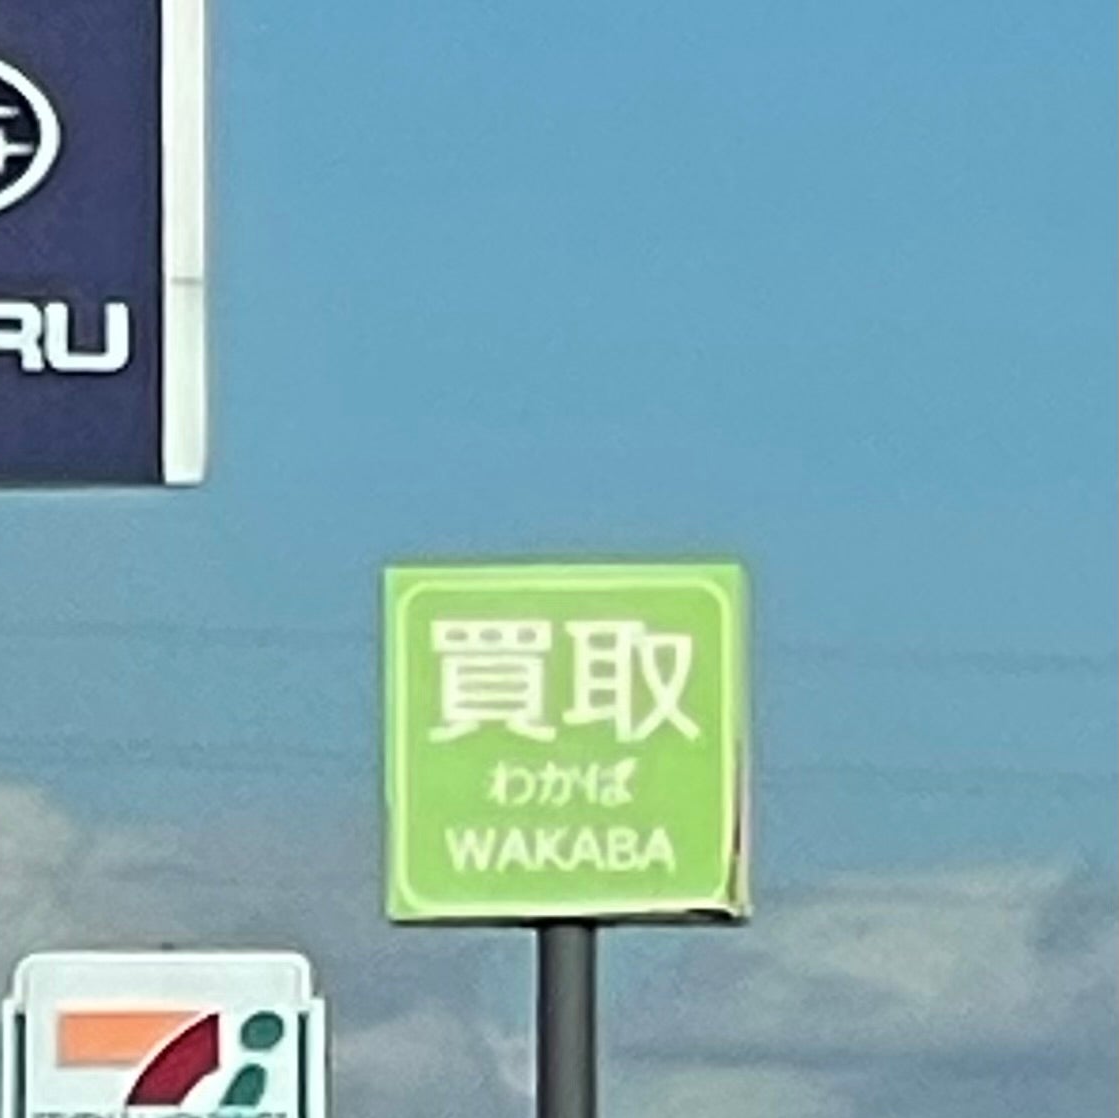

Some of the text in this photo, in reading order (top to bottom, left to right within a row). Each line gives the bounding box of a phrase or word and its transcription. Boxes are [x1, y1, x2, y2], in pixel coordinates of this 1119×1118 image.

[428, 620, 701, 742] 買取
[487, 757, 638, 807] わかば
[443, 827, 677, 873] WAKABA
